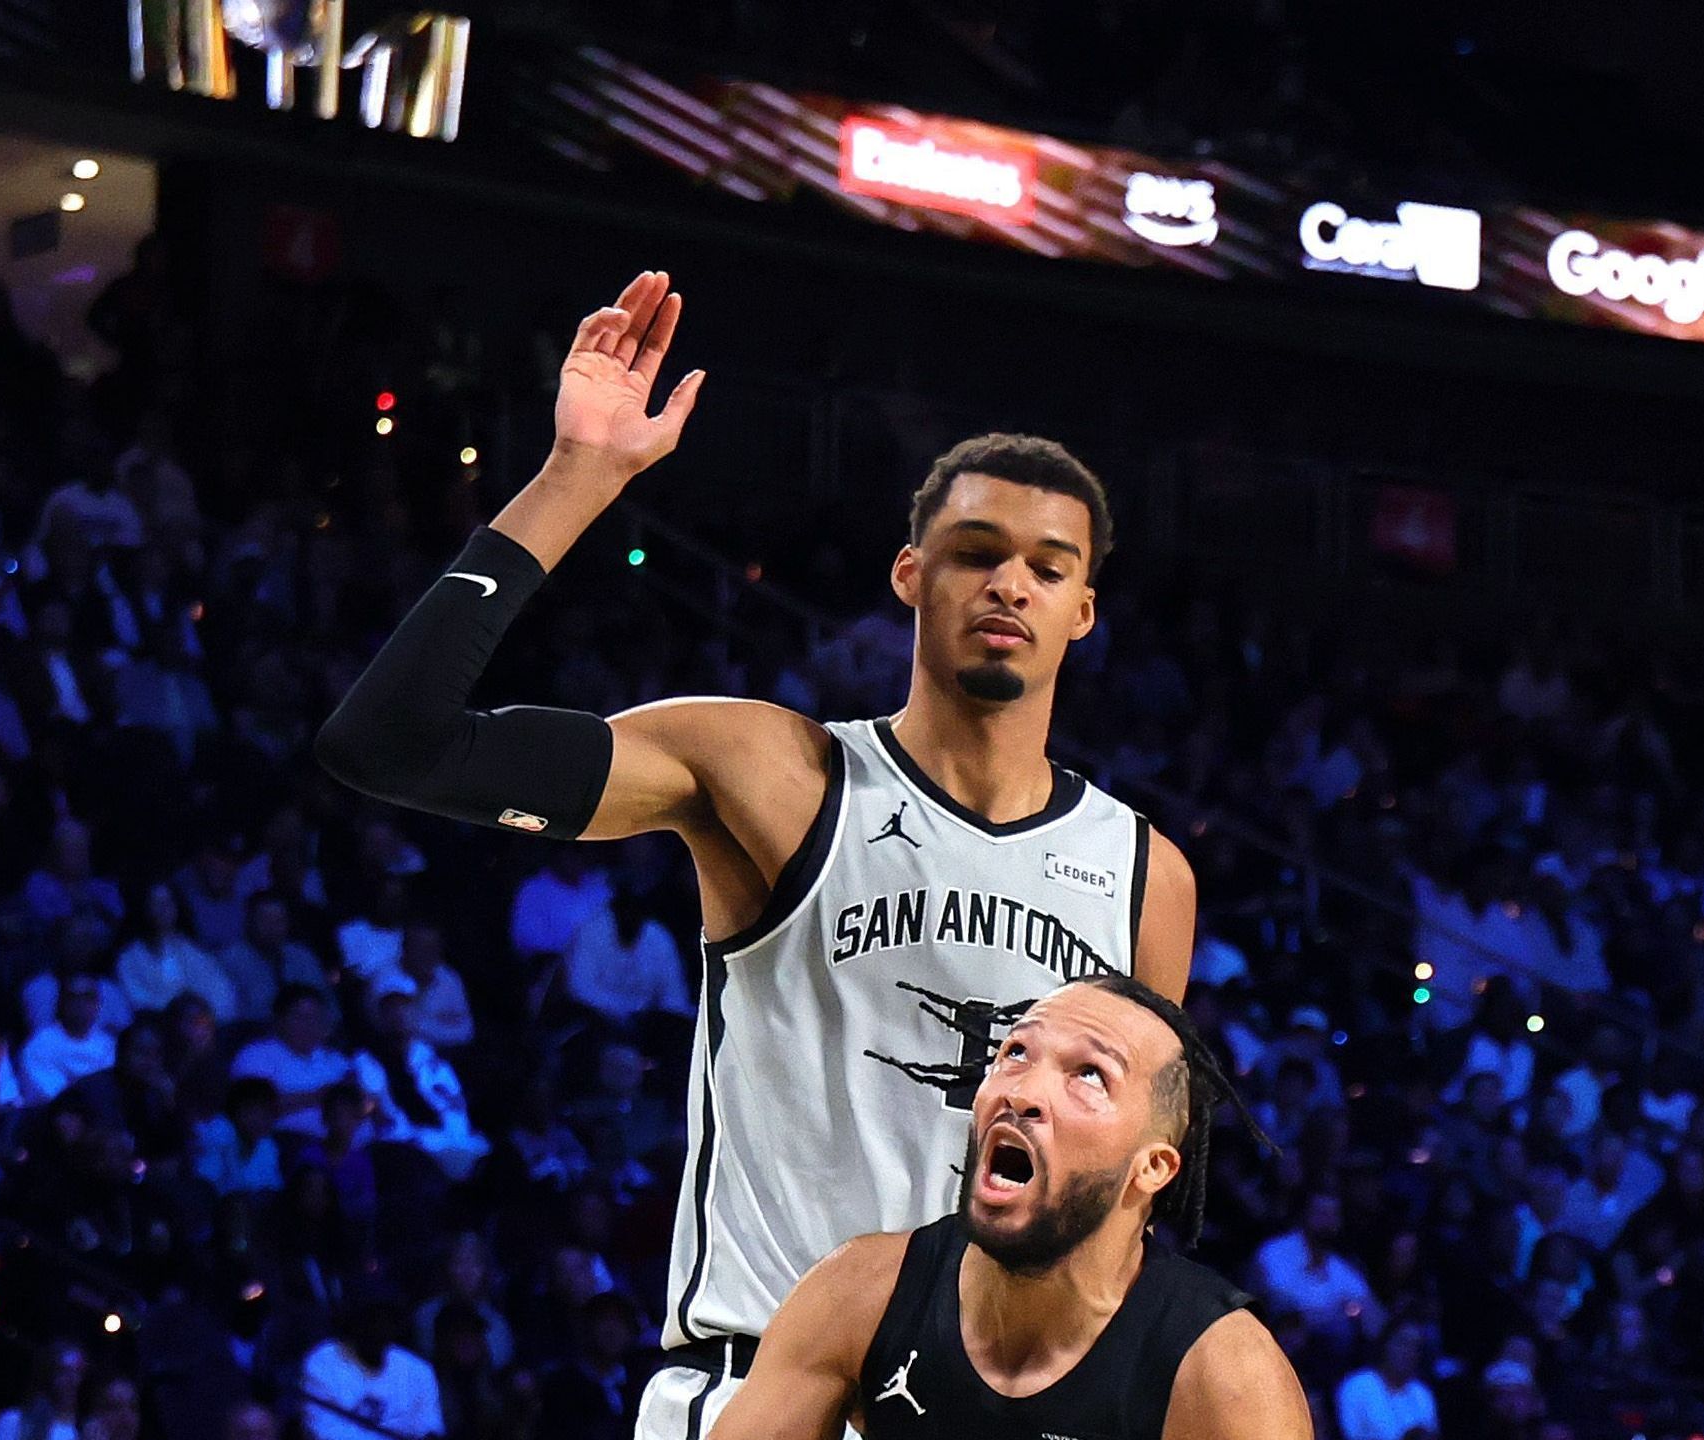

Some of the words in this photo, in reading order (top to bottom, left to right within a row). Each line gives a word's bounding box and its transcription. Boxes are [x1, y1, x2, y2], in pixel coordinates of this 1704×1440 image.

[1054, 862, 1106, 888] LEDGER
[832, 889, 928, 965] SAN
[935, 888, 1129, 980] ANTONI
